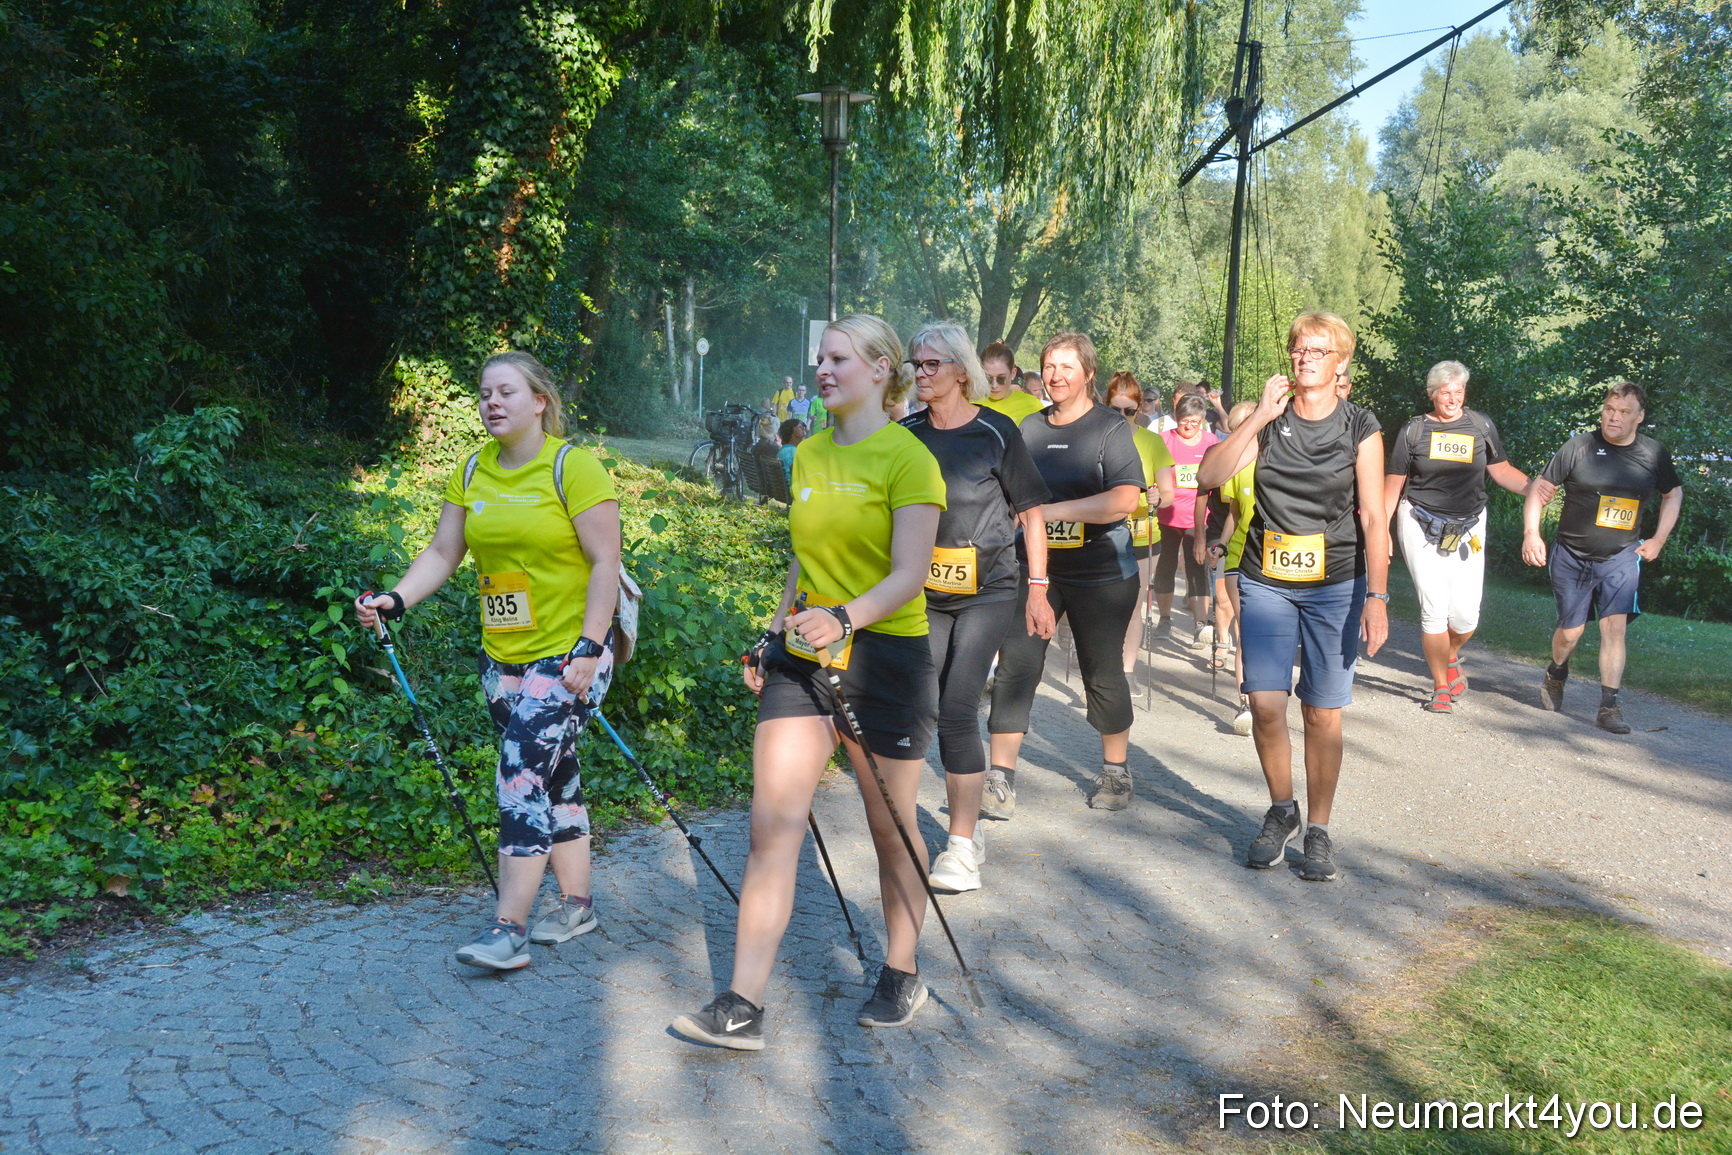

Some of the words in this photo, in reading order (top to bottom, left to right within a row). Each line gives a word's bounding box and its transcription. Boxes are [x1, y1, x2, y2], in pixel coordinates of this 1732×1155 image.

[1437, 442, 1467, 455] 1696
[1604, 507, 1634, 521] 1700
[1045, 520, 1076, 536] 647
[1270, 548, 1316, 569] 1643
[930, 562, 967, 581] 675
[487, 594, 518, 617] 935
[843, 702, 863, 735] LEKI
[645, 780, 671, 811] CARBN
